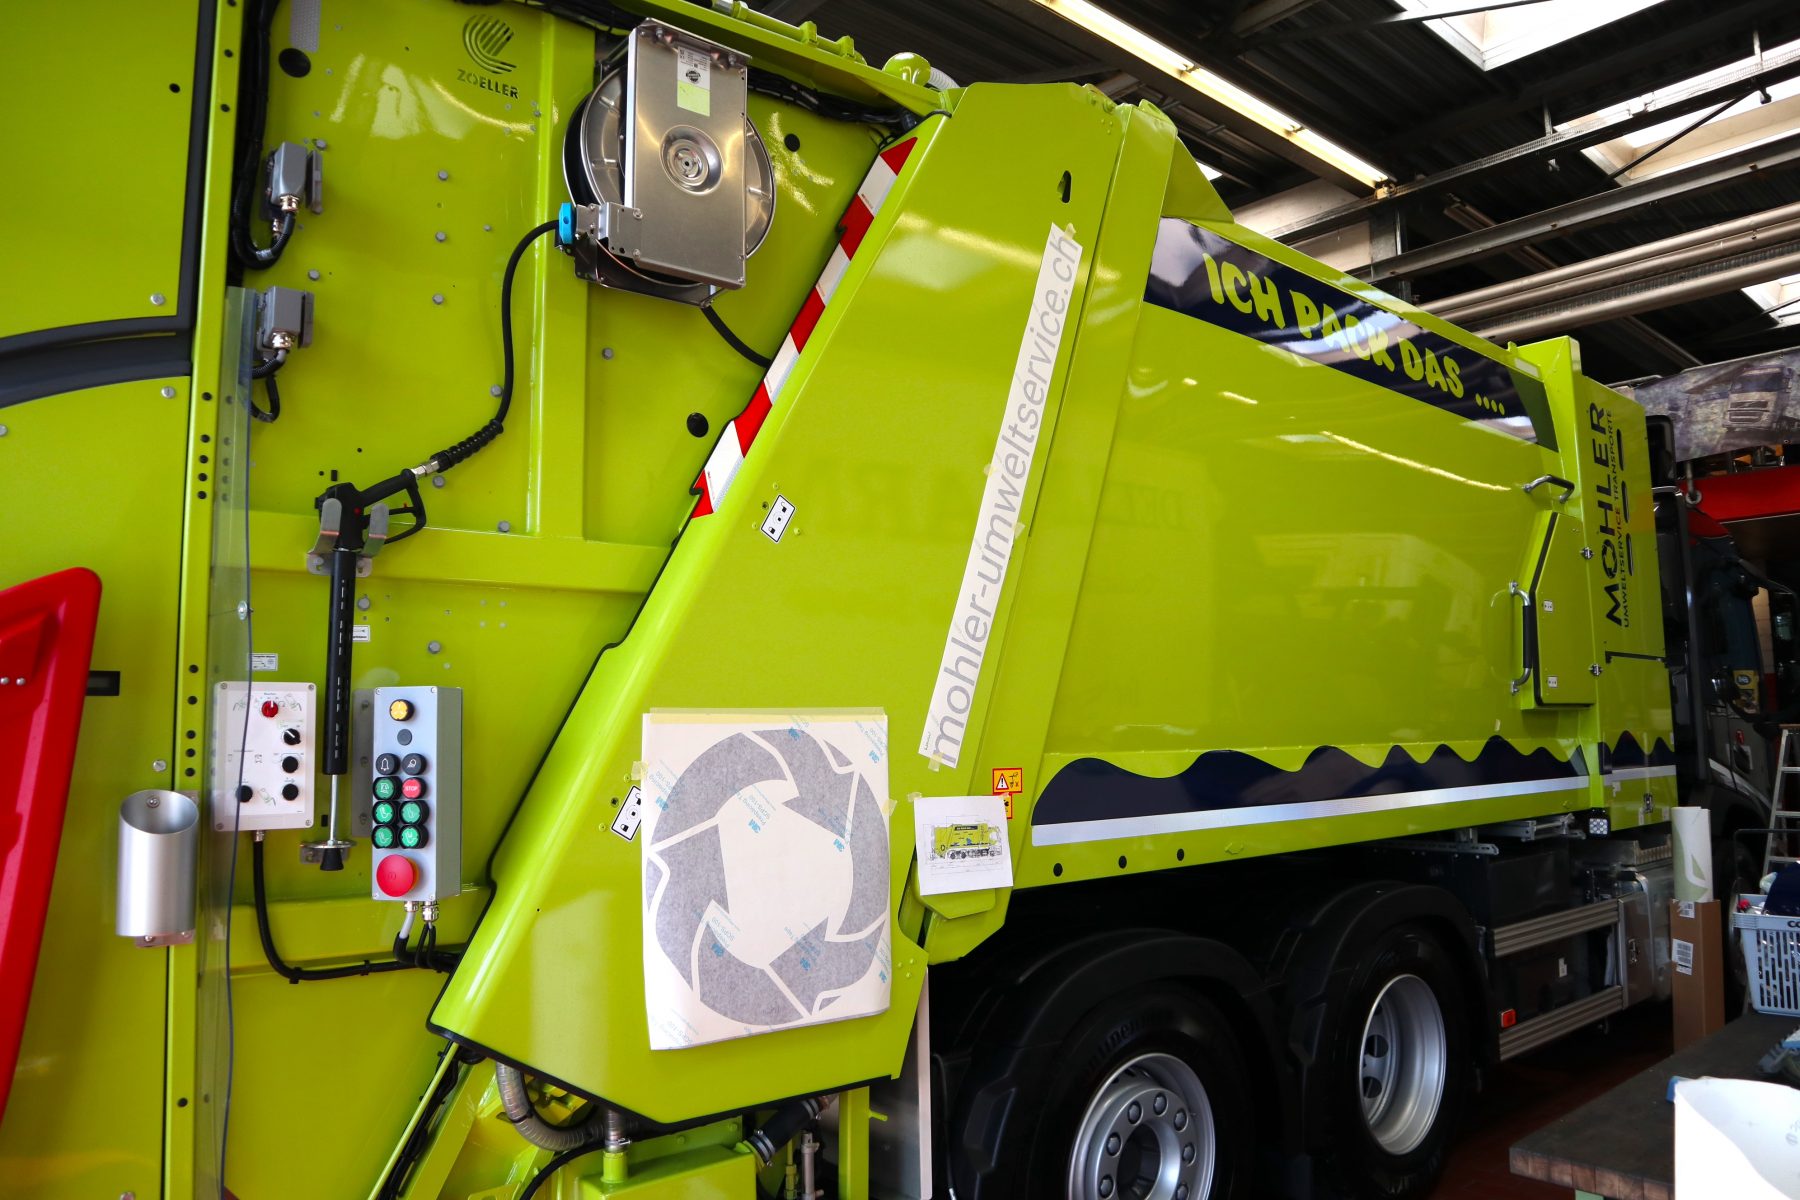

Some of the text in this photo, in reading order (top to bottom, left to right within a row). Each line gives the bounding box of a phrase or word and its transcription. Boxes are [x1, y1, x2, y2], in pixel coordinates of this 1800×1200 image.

[456, 68, 519, 99] ZOELLER
[1202, 252, 1286, 330] ICH
[1289, 289, 1395, 372] PACK
[1397, 336, 1464, 399] DAS
[933, 236, 1080, 766] mohler-umweltservice.ch
[1589, 402, 1623, 626] MOHLER
[1606, 410, 1629, 628] UMWELTSERVICE TRANSPORTE
[868, 749, 880, 764] 3M
[656, 796, 669, 812] 3M
[748, 818, 761, 833] 3M
[833, 838, 845, 853] 3M
